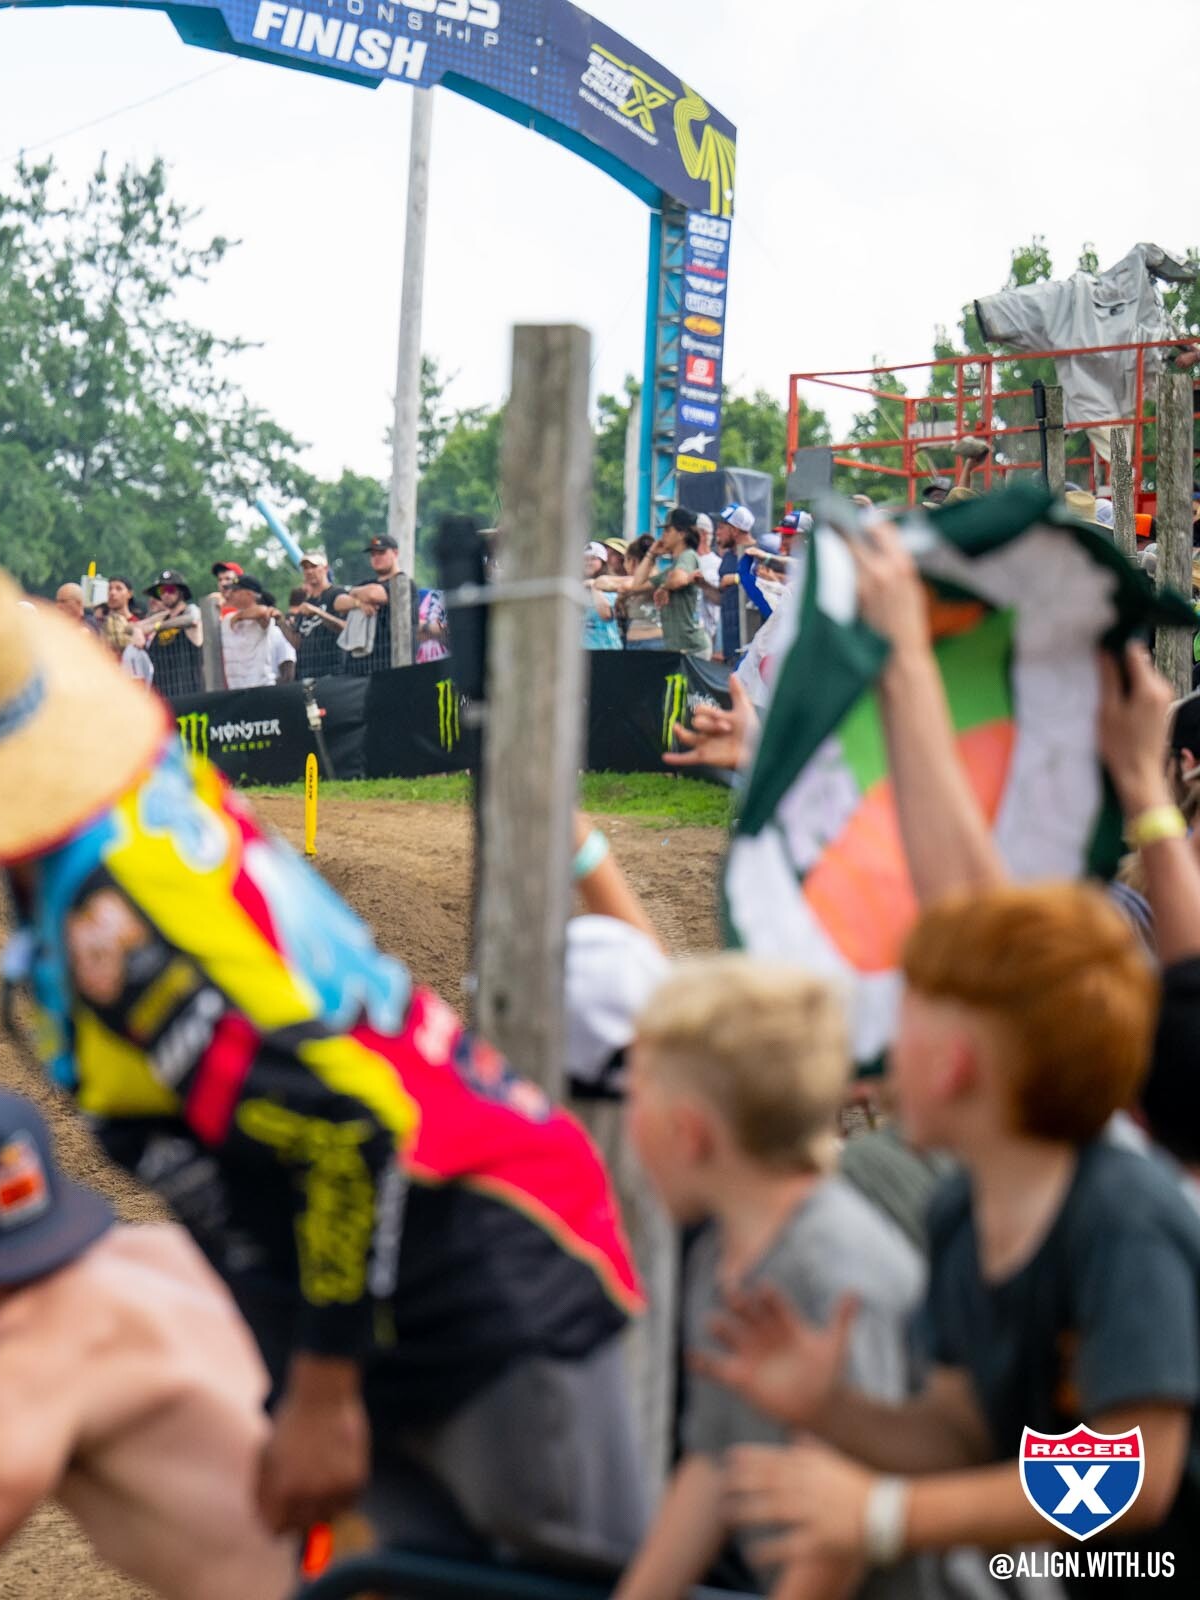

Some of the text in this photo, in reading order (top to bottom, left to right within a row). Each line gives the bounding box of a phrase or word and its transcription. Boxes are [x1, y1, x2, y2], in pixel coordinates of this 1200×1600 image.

[251, 0, 428, 81] FINISH
[209, 718, 282, 743] MONSTER
[221, 740, 271, 753] ENERGY
